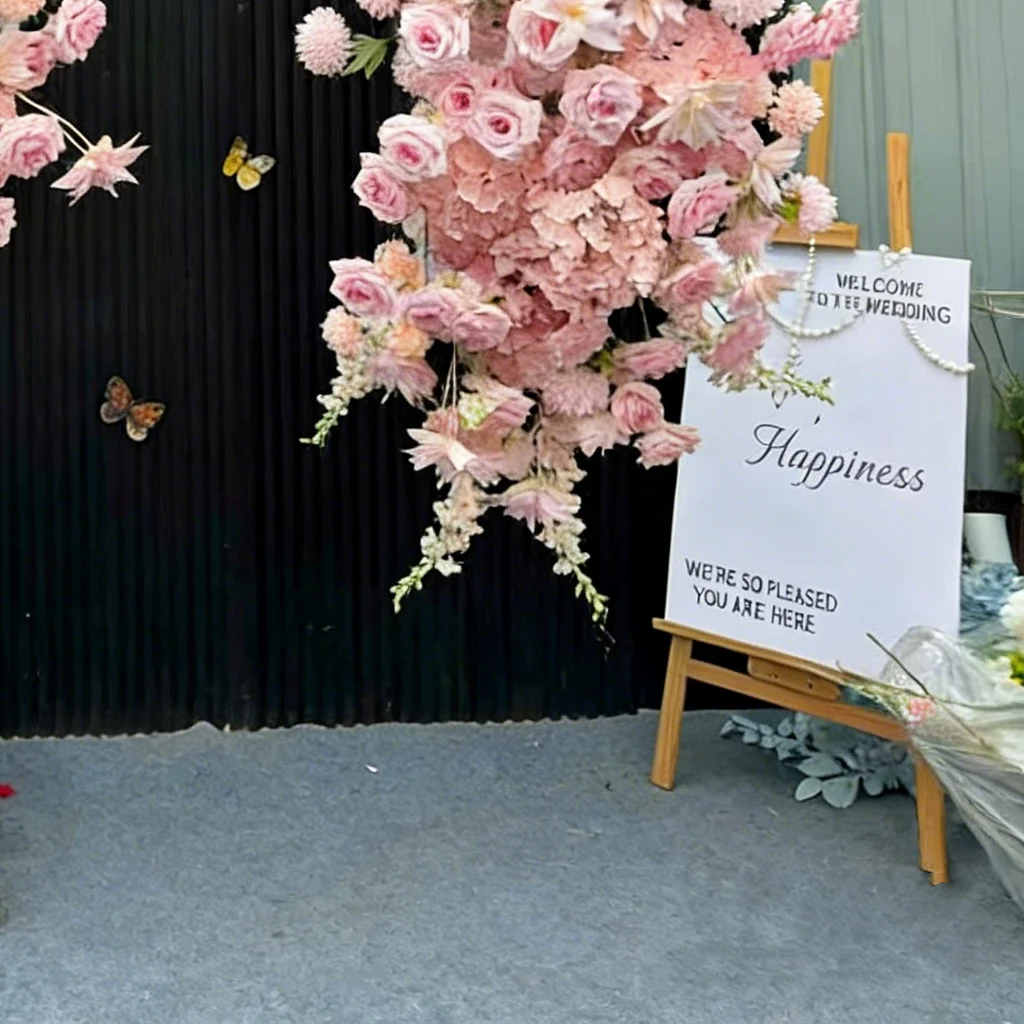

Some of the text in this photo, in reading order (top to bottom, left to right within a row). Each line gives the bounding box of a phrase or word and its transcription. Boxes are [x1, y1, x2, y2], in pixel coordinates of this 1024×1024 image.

[745, 423, 925, 492] Happiness
[693, 584, 816, 635] YOU ARE HERE
[742, 572, 763, 594] SO
[767, 579, 838, 613] PLEASED
